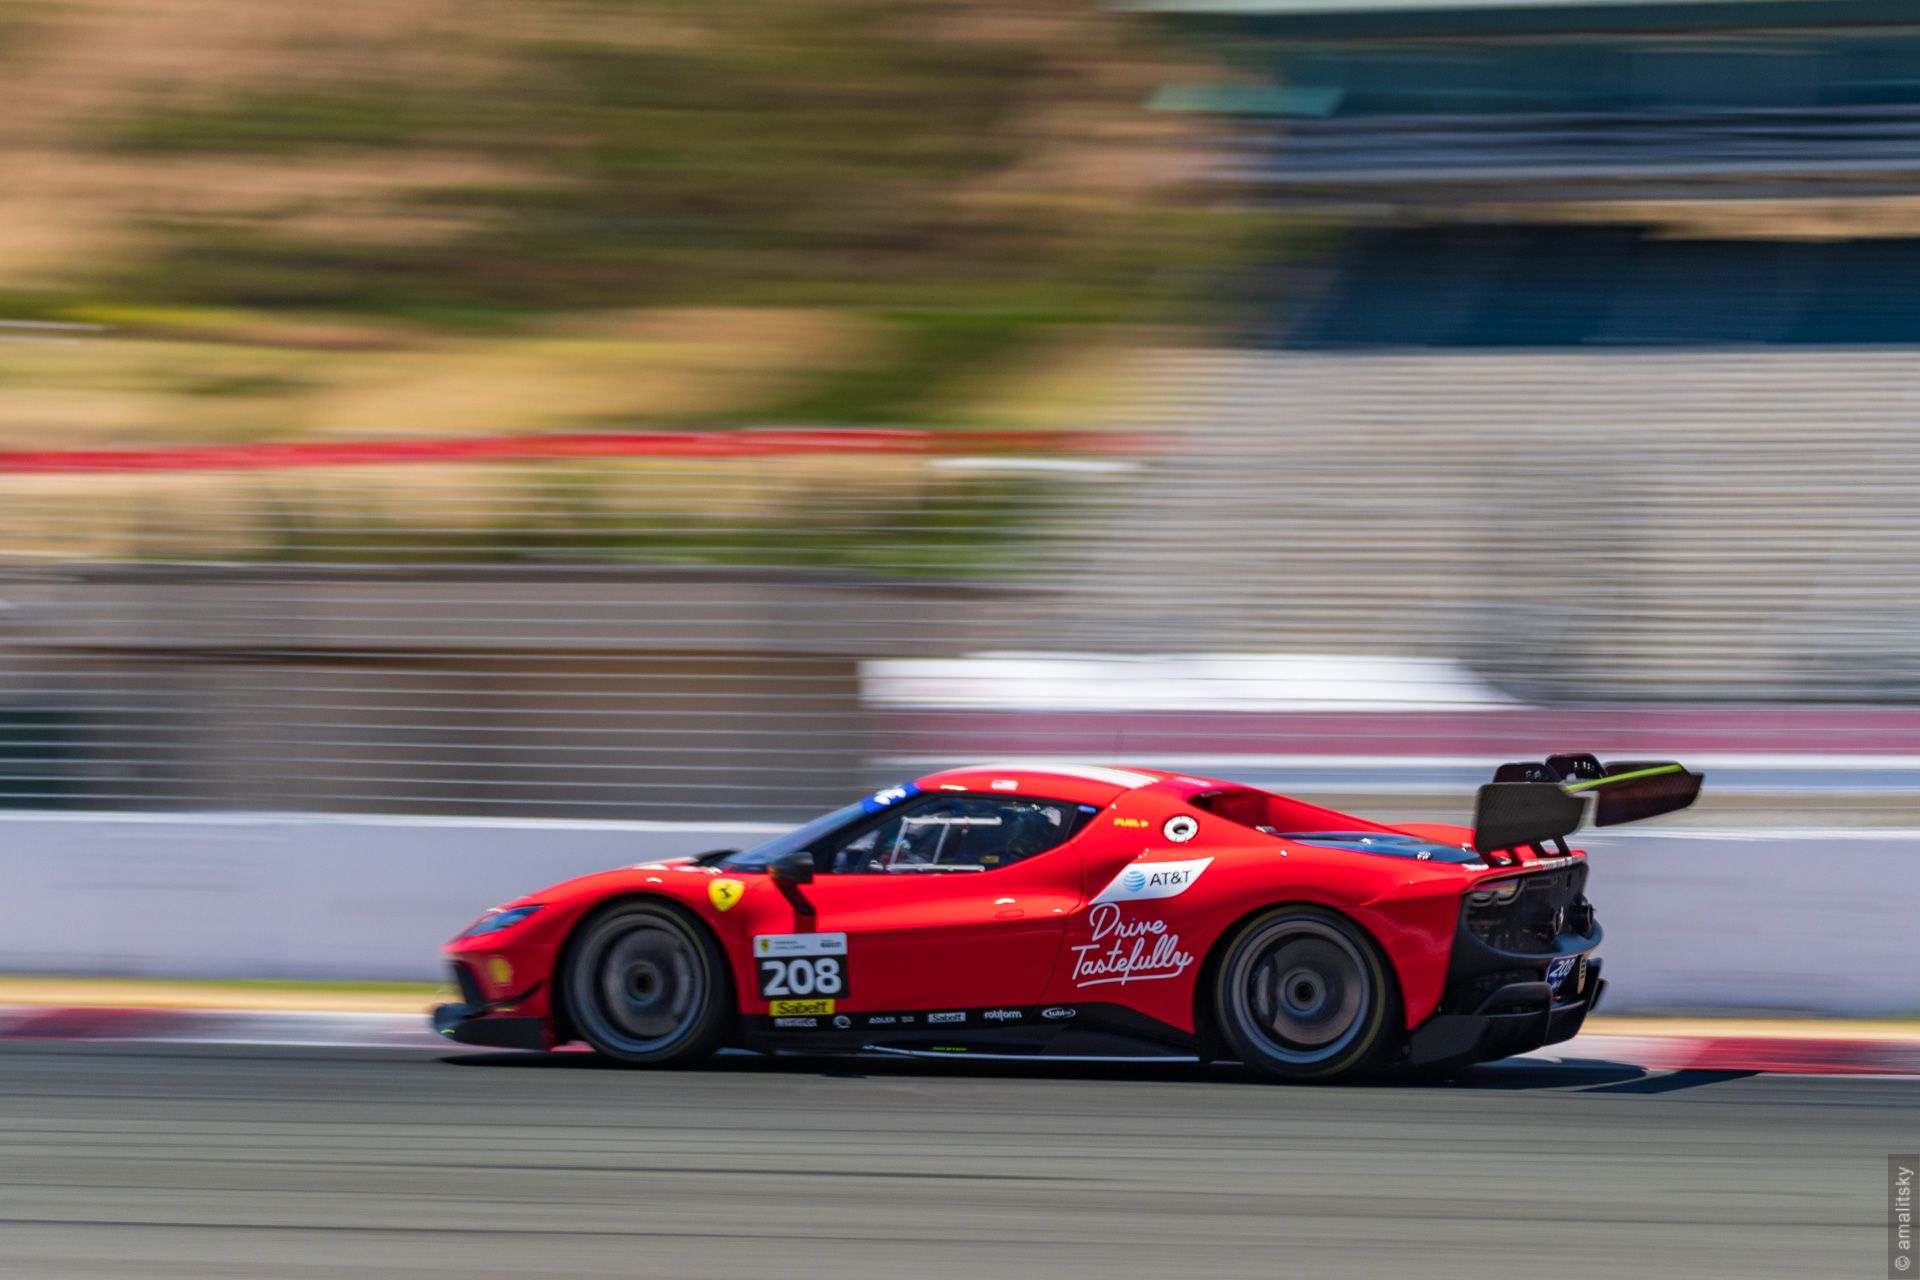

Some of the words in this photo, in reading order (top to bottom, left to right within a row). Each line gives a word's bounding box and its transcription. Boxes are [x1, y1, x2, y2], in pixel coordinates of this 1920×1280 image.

[1113, 818, 1140, 827] FUEL
[1149, 870, 1192, 887] AT&T
[1089, 902, 1168, 941] Drive
[1071, 934, 1194, 987] Tastefully
[1549, 959, 1576, 978] 208
[761, 958, 842, 996] 208
[777, 1001, 827, 1014] Sabelt
